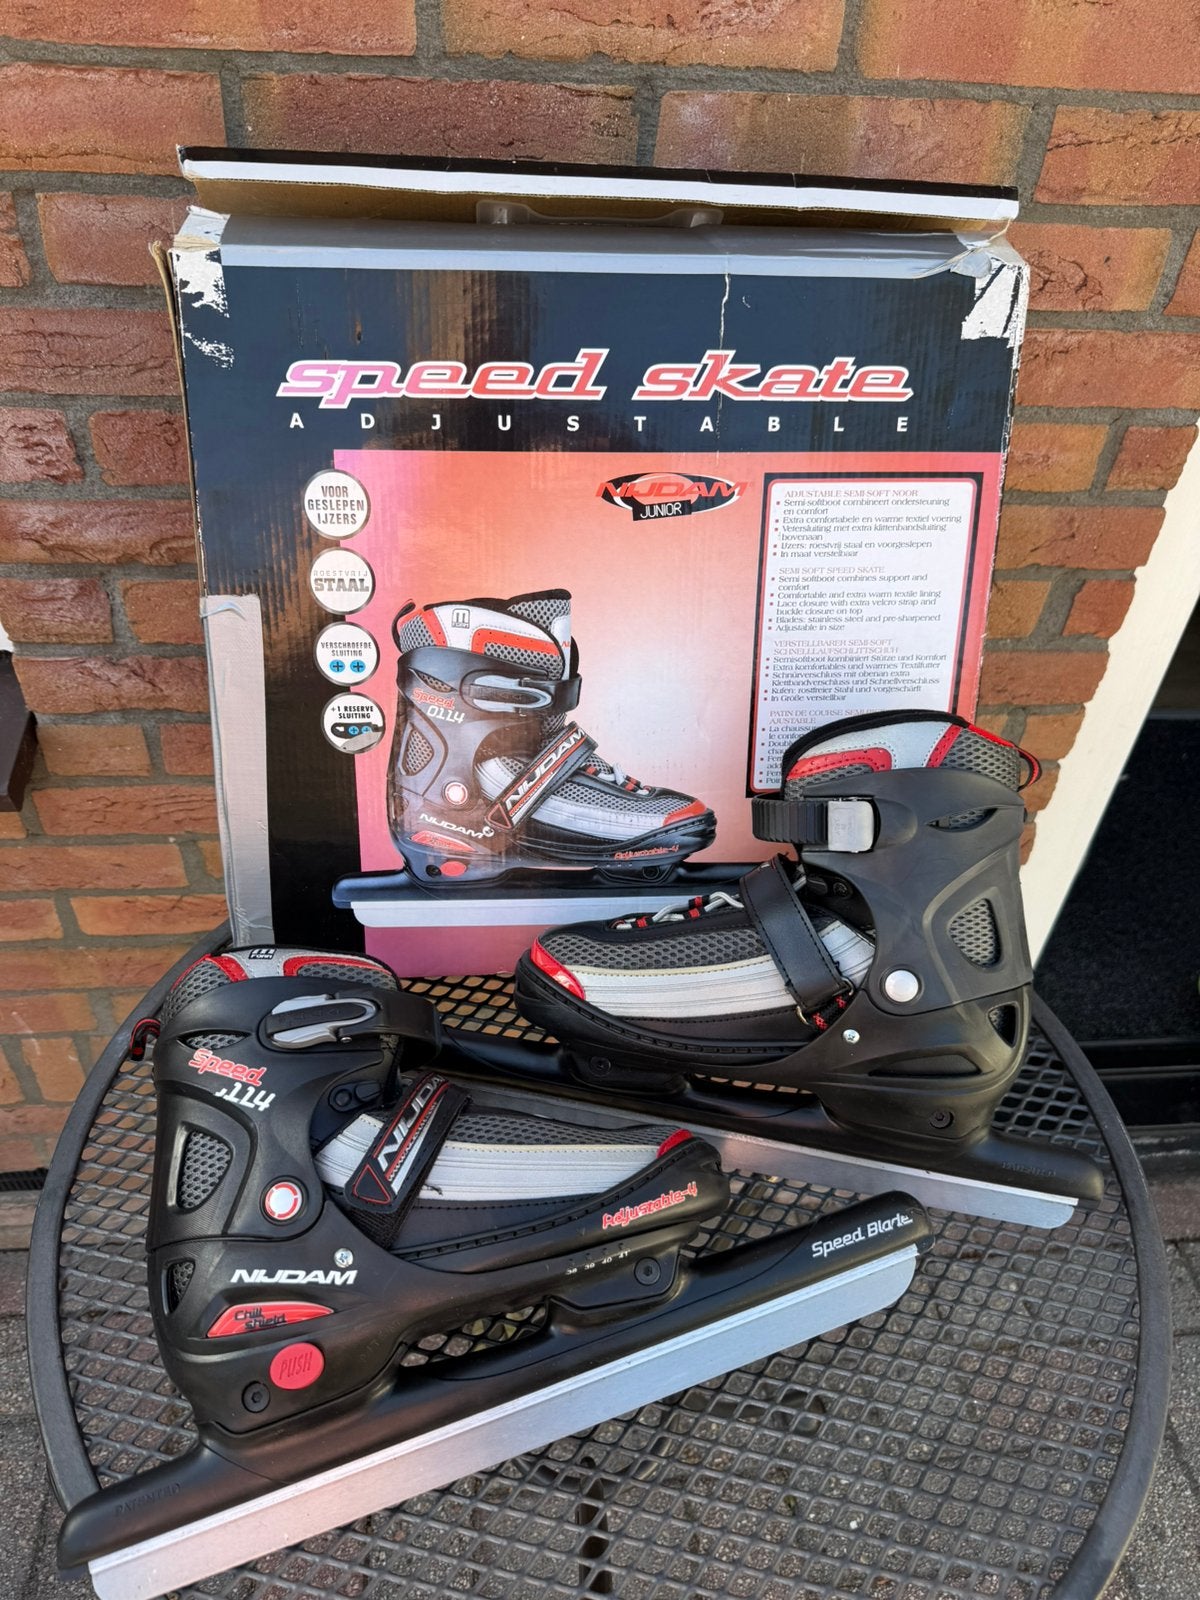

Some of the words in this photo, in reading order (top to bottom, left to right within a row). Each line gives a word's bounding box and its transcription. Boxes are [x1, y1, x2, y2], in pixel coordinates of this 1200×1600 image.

[276, 348, 609, 409] speed
[632, 350, 915, 402] skate
[289, 413, 908, 432] ADJUSTABLE
[321, 486, 348, 498] VOOR
[595, 481, 749, 497] NIJDAM
[784, 490, 841, 498] ADJUSTABLE
[892, 489, 918, 497] NOOR
[307, 499, 364, 511] GESLEPEN
[843, 498, 889, 506] combineert
[891, 498, 950, 507] ondersteuning
[640, 502, 682, 518] JUNIOR
[317, 513, 357, 525] IJZERS
[783, 516, 804, 524] Extra
[906, 515, 929, 523] textiel
[783, 525, 832, 533] Vetersluiting
[874, 524, 947, 532] klittenbandsluiting
[809, 542, 841, 550] roestvrij
[878, 541, 933, 549] voorgeslepen
[314, 578, 369, 592] STAAL
[920, 590, 941, 598] lining
[898, 599, 918, 607] strap
[849, 608, 863, 616] top
[808, 615, 842, 623] stainless
[844, 615, 863, 623] steel
[776, 624, 817, 632] Adjustable
[797, 686, 832, 694] rostfreier
[412, 687, 455, 710] Speed
[427, 705, 465, 724] 0114
[419, 813, 485, 839] NIJDAM
[188, 1048, 267, 1087] Speed
[811, 1227, 866, 1258] Speed
[866, 1212, 913, 1237] Blade
[230, 1269, 358, 1286] NIJDAM
[234, 1308, 262, 1321] Chill
[279, 1351, 313, 1381] PUSH
